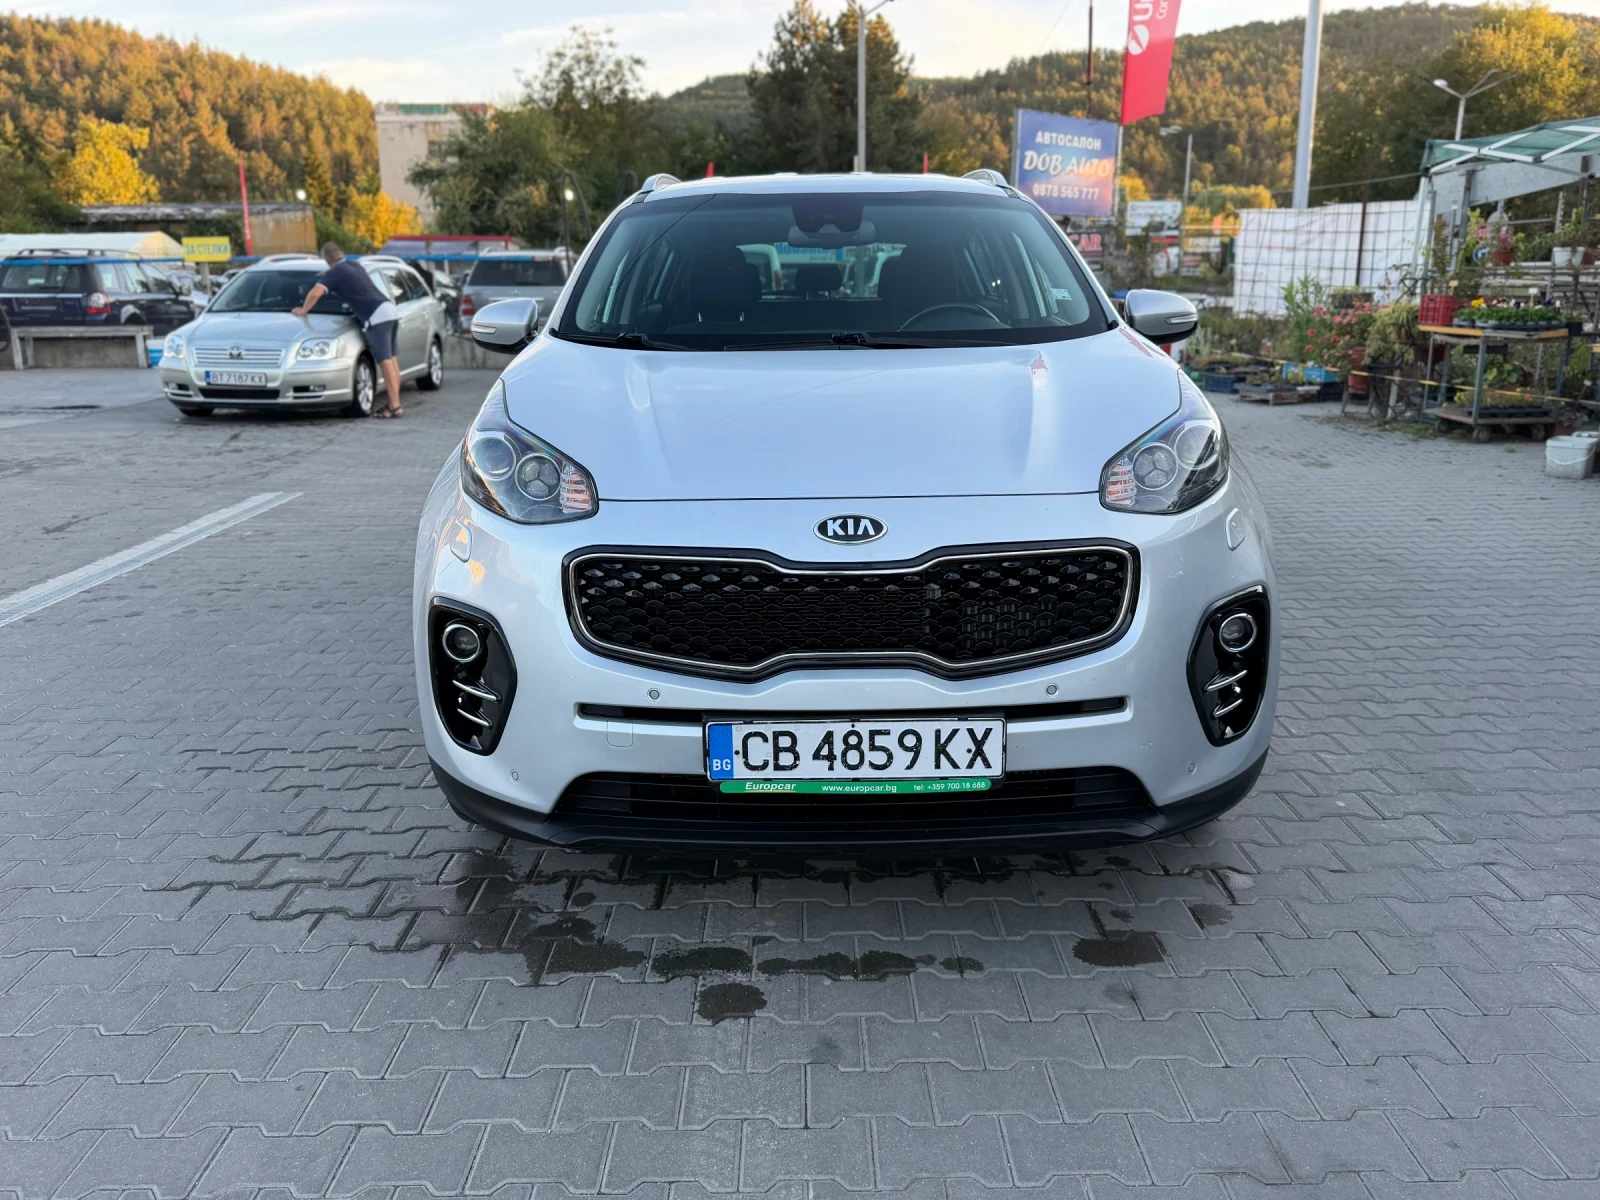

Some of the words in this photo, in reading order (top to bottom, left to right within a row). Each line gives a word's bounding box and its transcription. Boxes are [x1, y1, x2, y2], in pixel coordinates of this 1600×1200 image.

[1035, 130, 1101, 151] АВТОСАЛОН
[1023, 150, 1063, 176] DOB
[1032, 182, 1059, 198] 0878
[1081, 187, 1100, 200] 777
[826, 518, 876, 537] KIA
[741, 730, 801, 772] CB
[811, 729, 923, 771] 4859
[933, 728, 993, 770] KX
[712, 759, 731, 771] BG
[744, 782, 797, 792] Europcar
[821, 784, 897, 793] www.europcar.bg
[947, 782, 960, 790] 700
